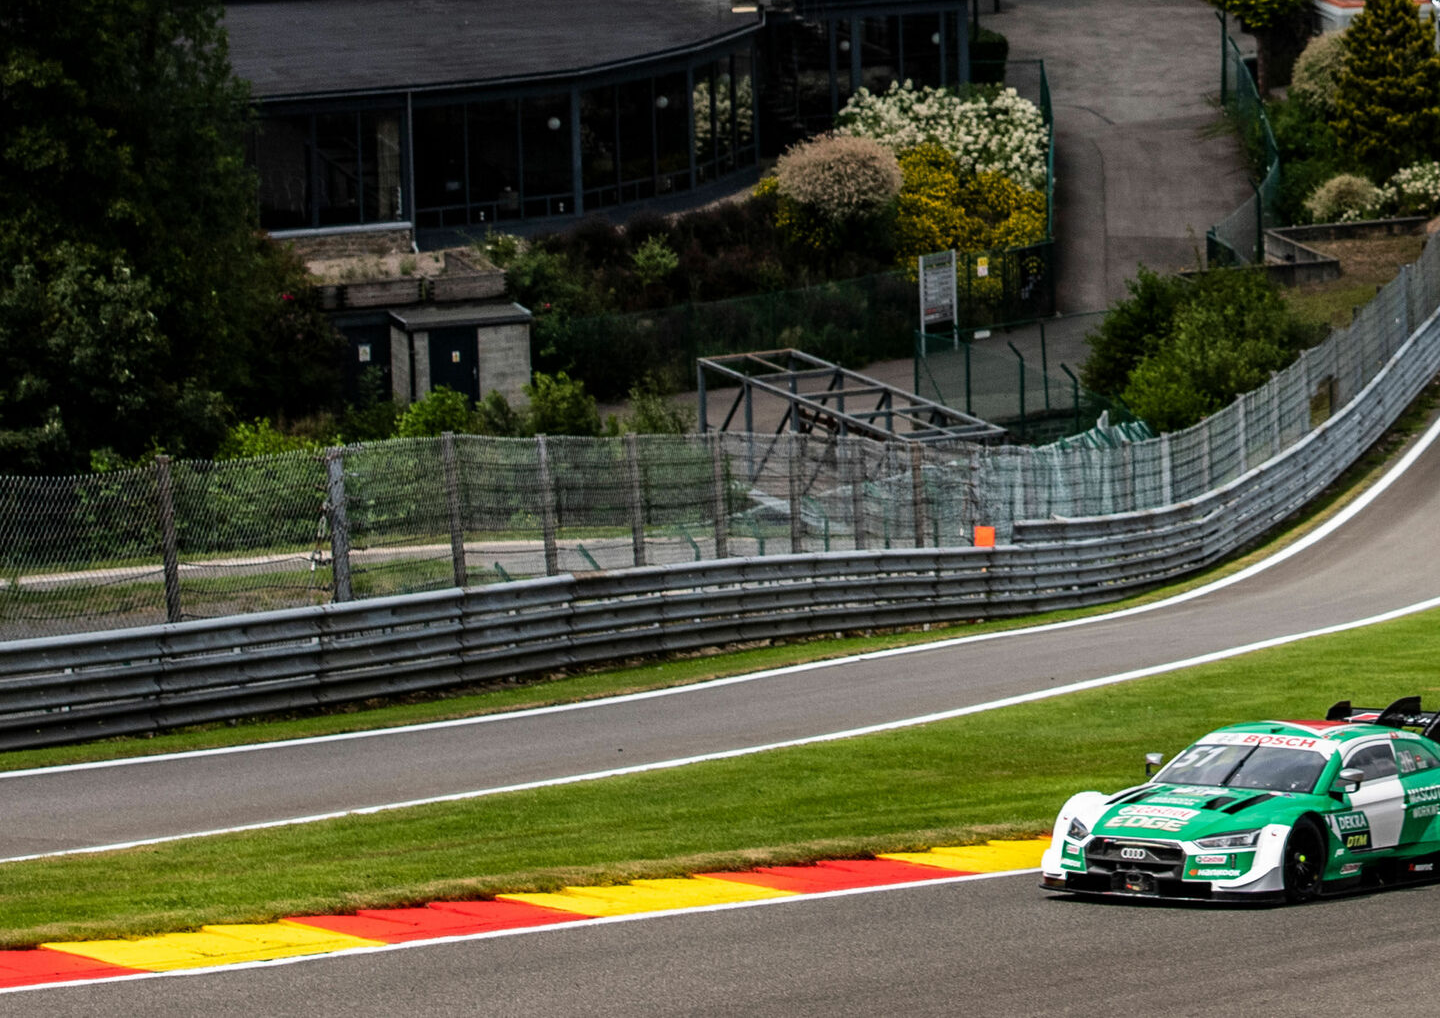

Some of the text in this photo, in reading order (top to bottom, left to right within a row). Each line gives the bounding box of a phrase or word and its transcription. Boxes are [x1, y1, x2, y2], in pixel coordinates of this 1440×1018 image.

[1243, 734, 1316, 749] BOSCH
[1172, 745, 1229, 768] 51
[1407, 784, 1440, 803] MASCOT
[1131, 804, 1193, 819] Castrol
[1104, 815, 1190, 832] EDGE
[1339, 813, 1367, 830] DEKRA
[1346, 833, 1368, 848] DTM
